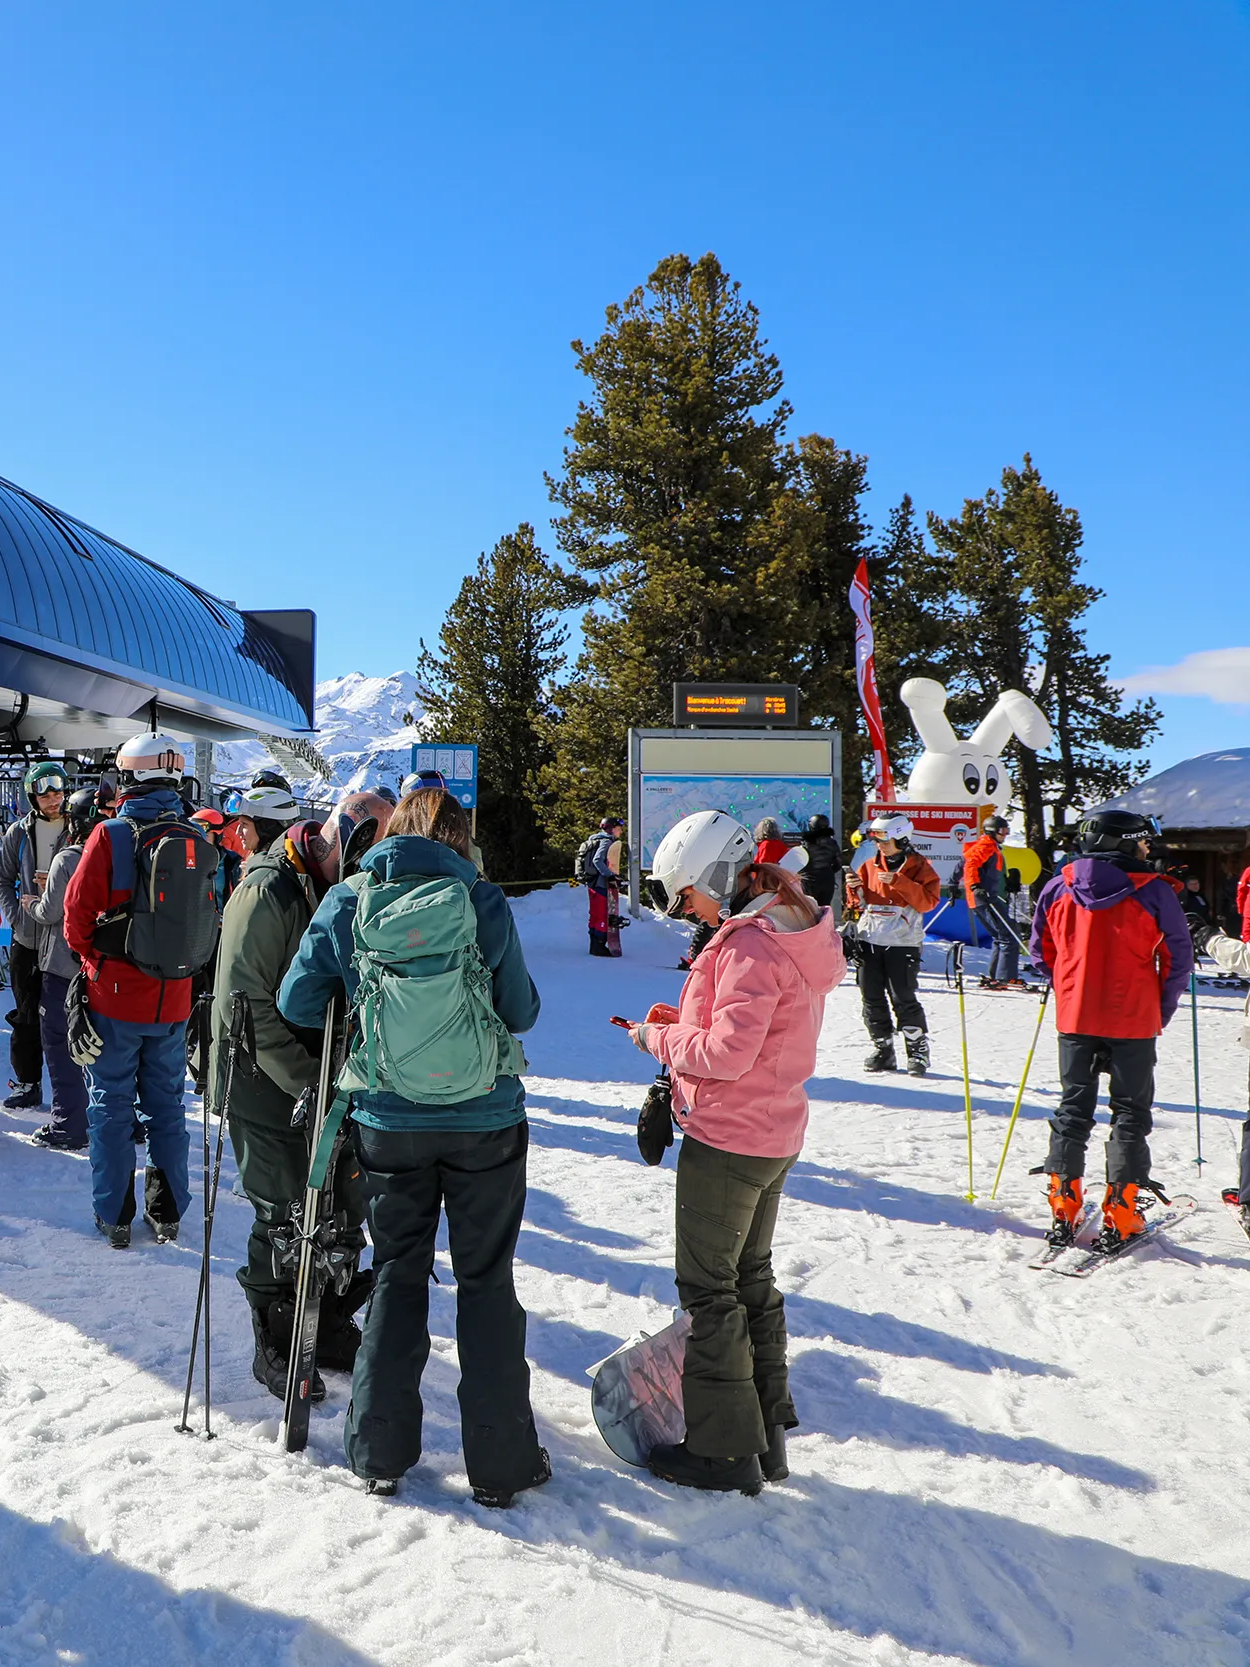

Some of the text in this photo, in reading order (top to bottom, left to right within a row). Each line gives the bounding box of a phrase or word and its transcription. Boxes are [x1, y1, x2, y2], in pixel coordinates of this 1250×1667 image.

[920, 811, 930, 819] DE
[931, 811, 943, 819] SKI
[944, 811, 973, 820] NENDAZ
[1121, 829, 1149, 839] GIRO
